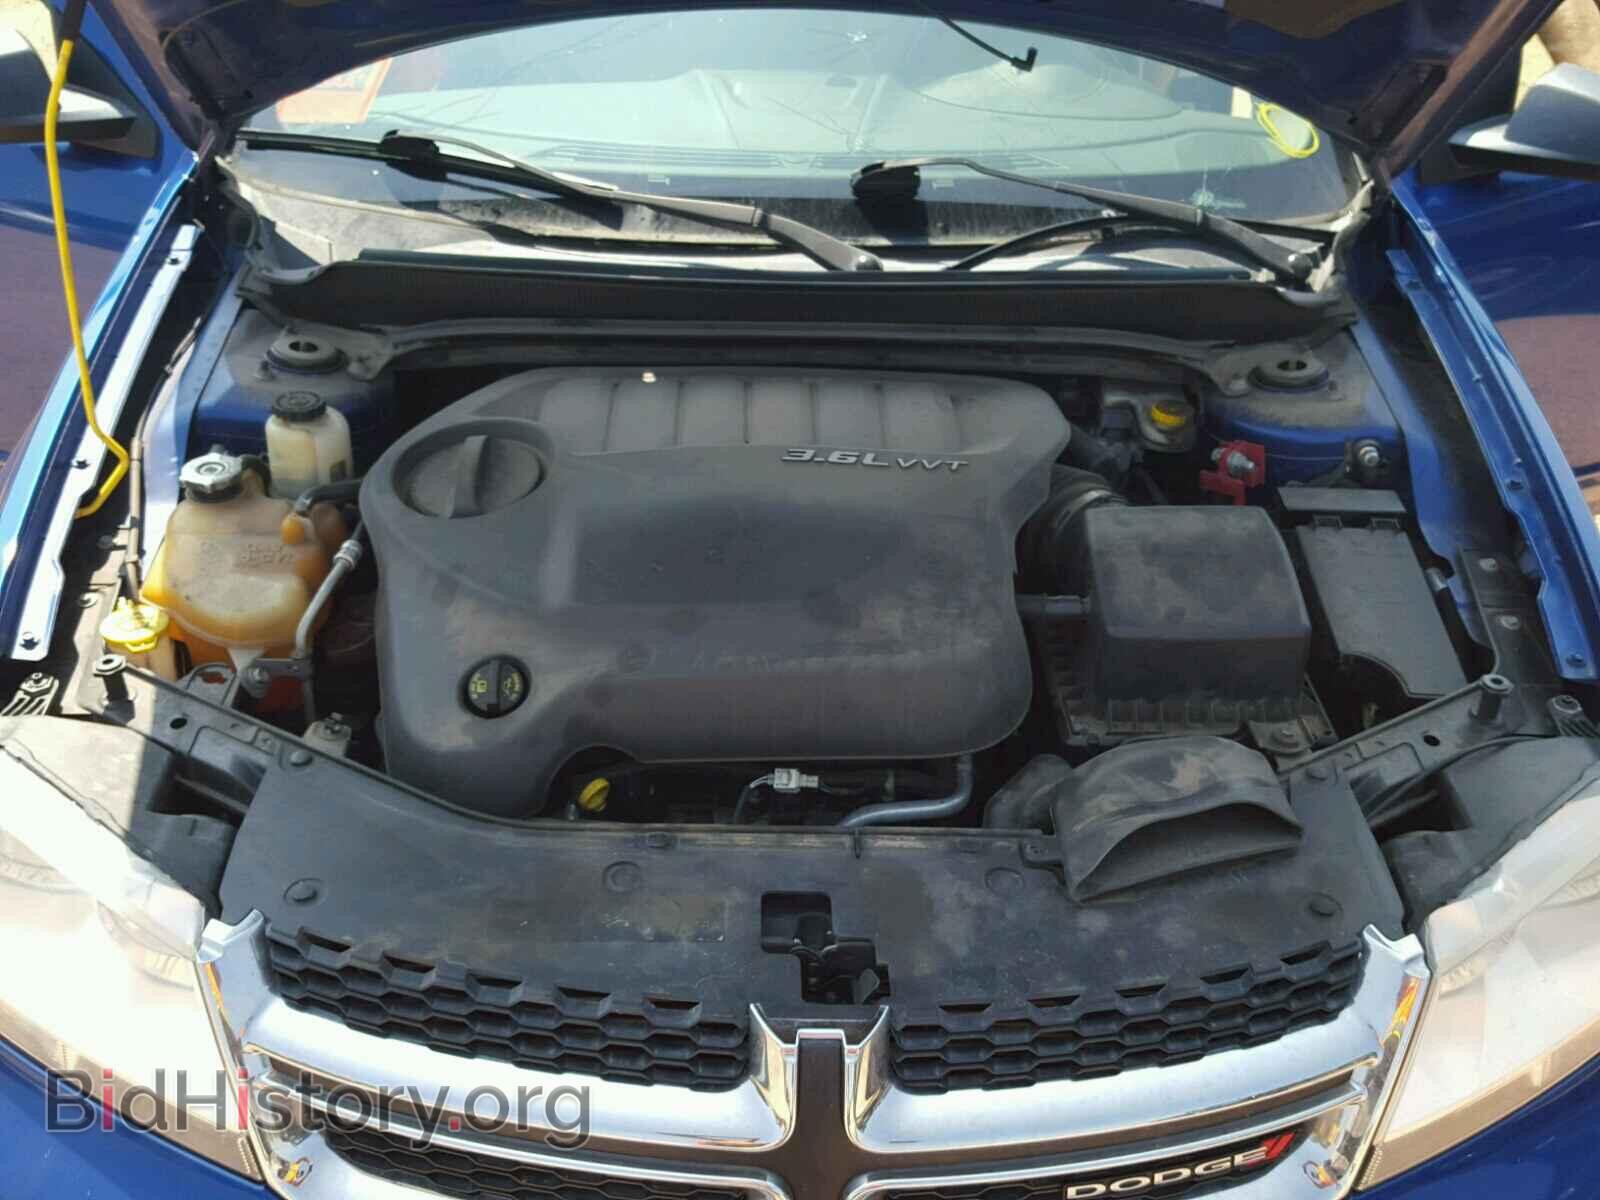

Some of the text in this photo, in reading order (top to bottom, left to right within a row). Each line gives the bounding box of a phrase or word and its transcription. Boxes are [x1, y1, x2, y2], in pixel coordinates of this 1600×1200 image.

[781, 448, 969, 471] 3.6L VVT
[1065, 1146, 1269, 1200] DODGE
